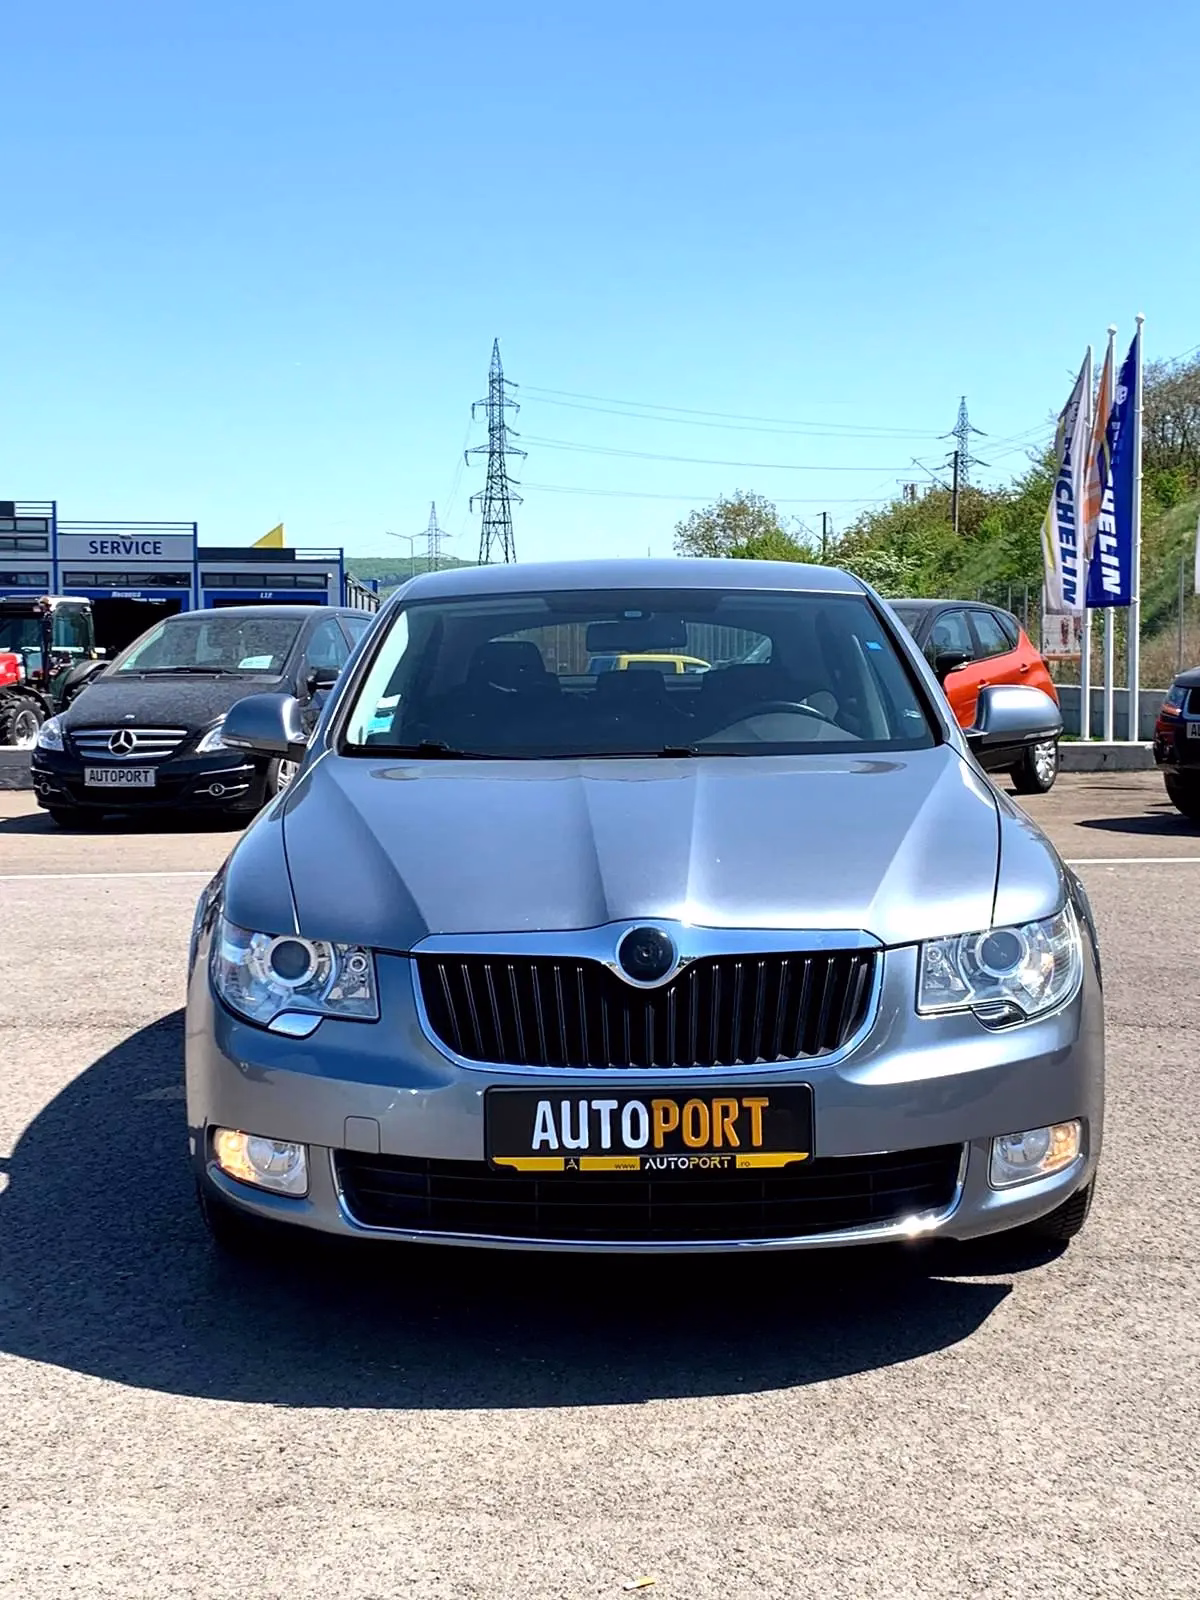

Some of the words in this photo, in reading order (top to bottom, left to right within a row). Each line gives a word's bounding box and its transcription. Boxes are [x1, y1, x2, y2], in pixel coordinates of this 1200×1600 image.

[88, 540, 162, 555] SERVICE
[89, 769, 150, 783] AUTOPORT
[531, 1097, 769, 1150] AUTOPORT
[645, 1156, 732, 1170] AUTOPORT
